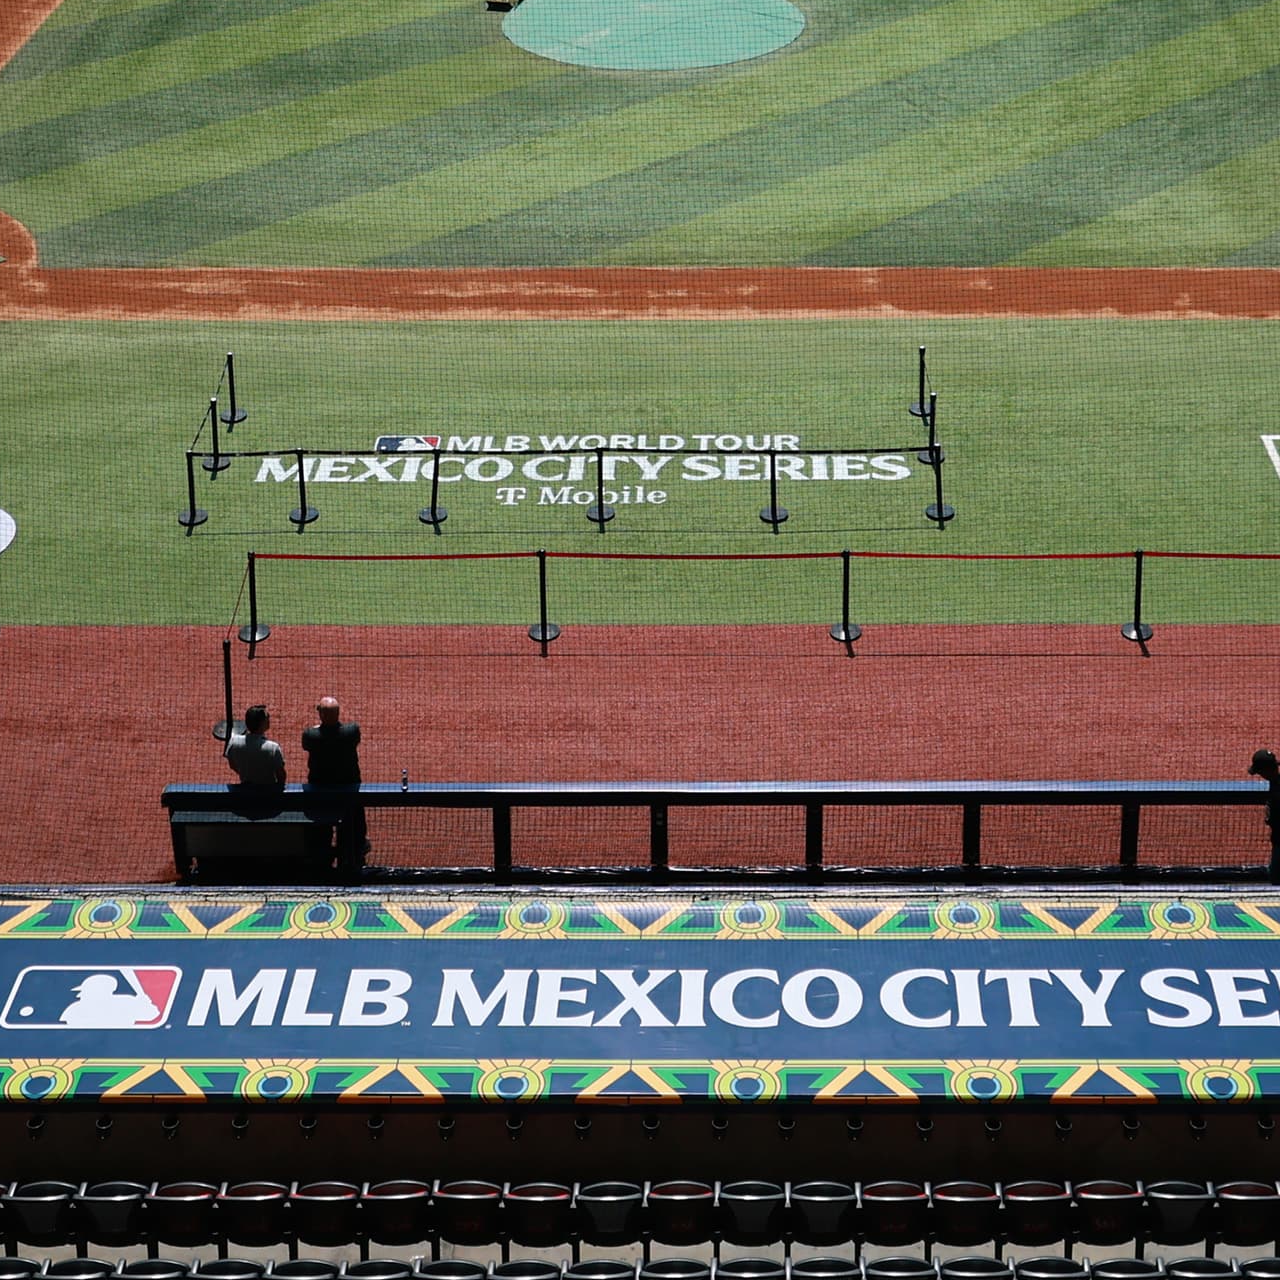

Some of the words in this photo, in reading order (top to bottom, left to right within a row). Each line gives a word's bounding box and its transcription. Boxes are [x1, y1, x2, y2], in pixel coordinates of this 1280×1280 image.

[445, 434, 532, 452] MLB
[537, 434, 685, 452] WORLD
[690, 433, 800, 452] TOUR
[252, 455, 515, 483] MEXICO
[521, 455, 675, 482] CITY
[681, 454, 911, 481] SERIES
[536, 485, 668, 506] Mobile
[187, 968, 413, 1026] MLB
[434, 967, 863, 1028] MEXICO
[879, 967, 1125, 1028] CITY
